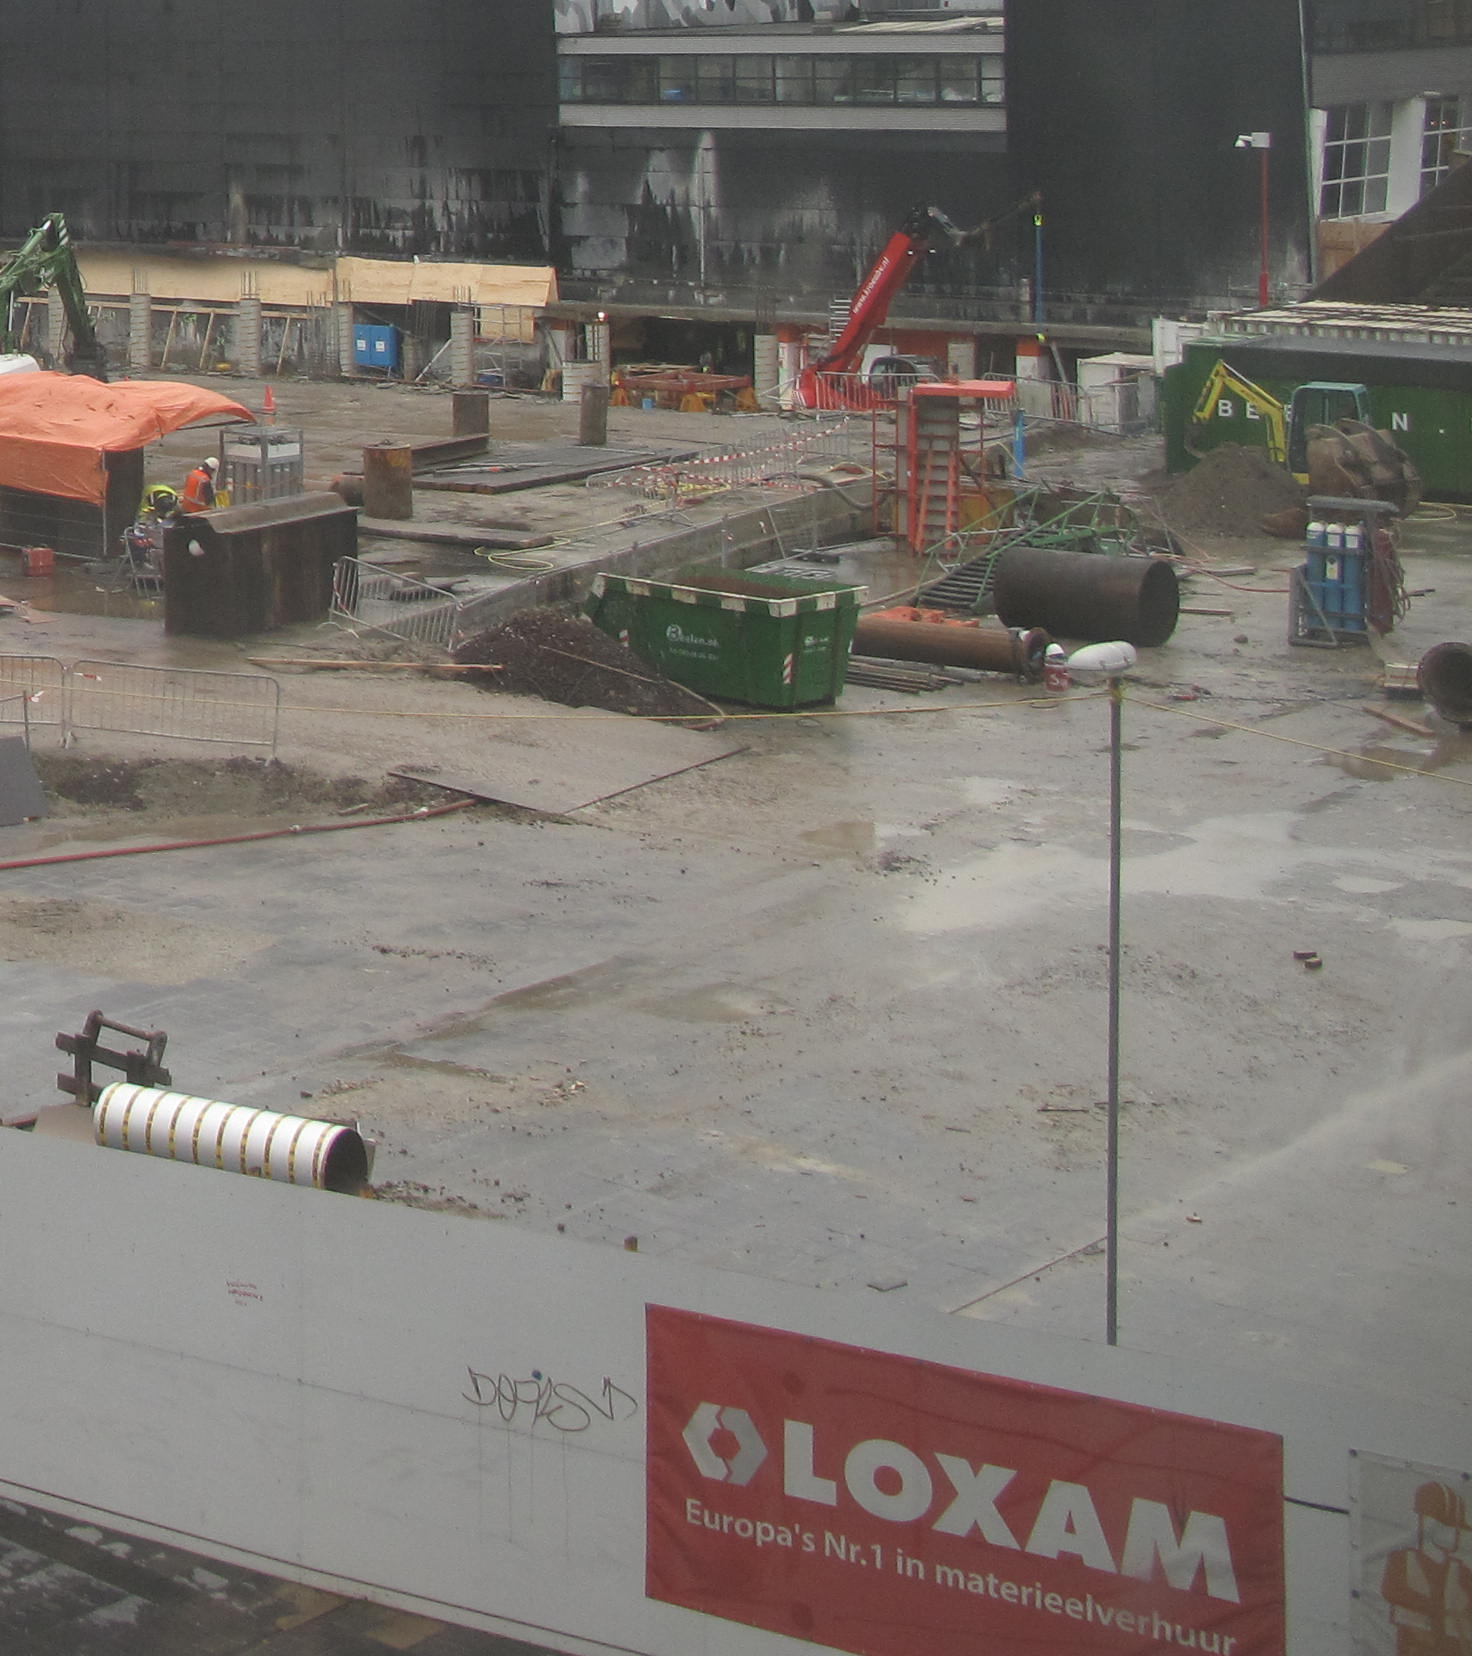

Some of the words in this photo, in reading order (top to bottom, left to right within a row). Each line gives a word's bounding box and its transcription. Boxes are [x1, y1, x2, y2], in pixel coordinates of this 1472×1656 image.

[685, 1497, 816, 1553] Europa's
[823, 1529, 884, 1570] Nr.1
[896, 1548, 925, 1580] in
[936, 1565, 1238, 1656] materieelverhuur
[783, 1417, 1241, 1604] LOXAM
